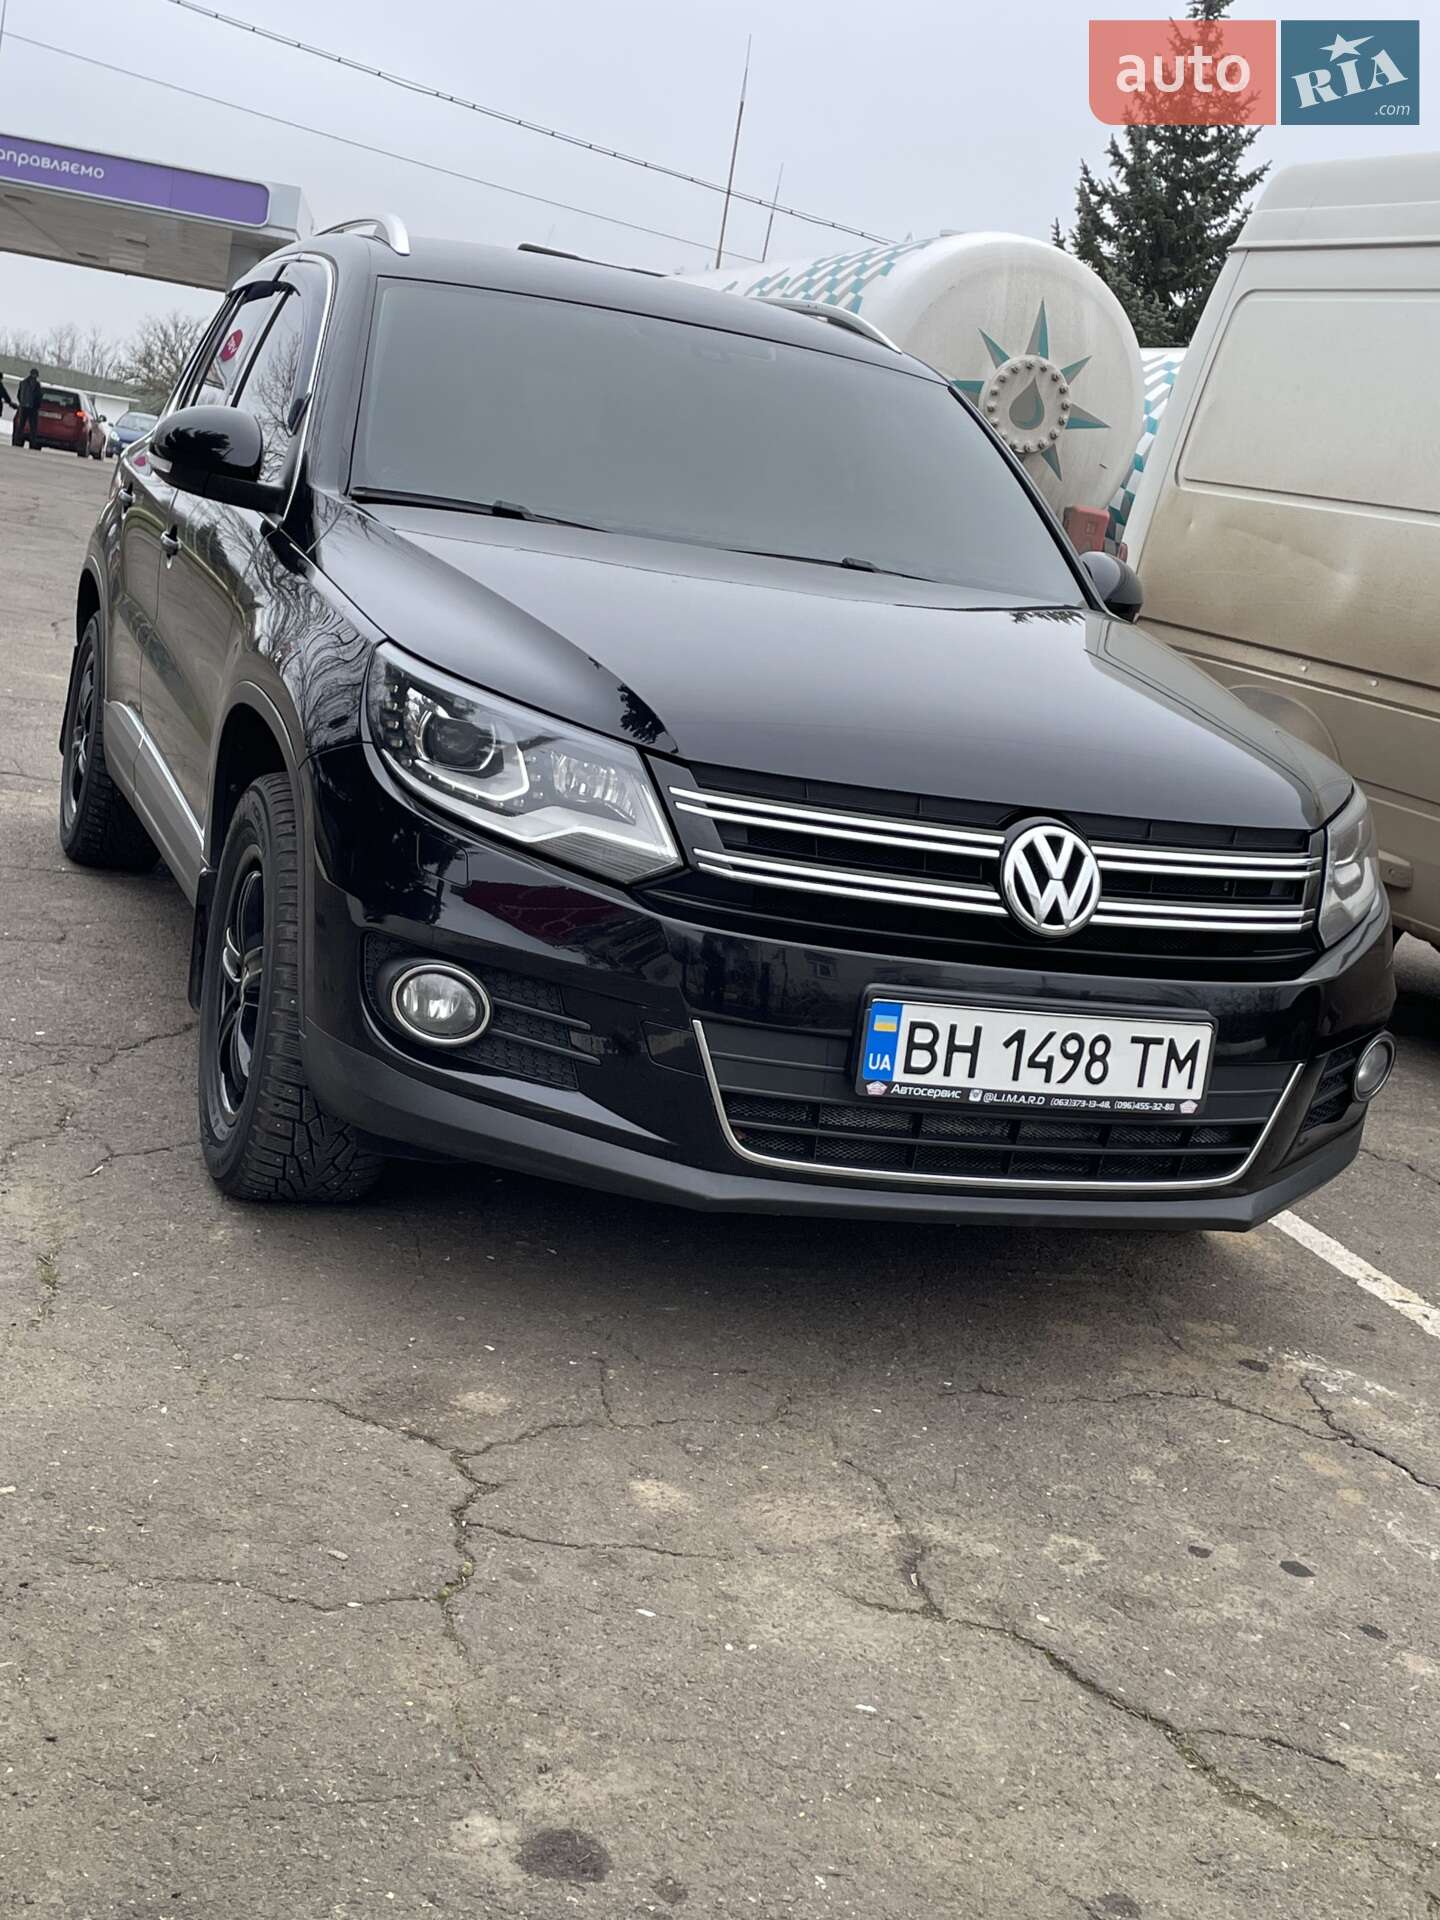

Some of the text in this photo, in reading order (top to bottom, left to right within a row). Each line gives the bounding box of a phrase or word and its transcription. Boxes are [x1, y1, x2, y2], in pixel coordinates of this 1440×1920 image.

[868, 1053, 891, 1072] UA
[1003, 1028, 1112, 1085] 1498
[890, 1083, 963, 1100] Автосервис
